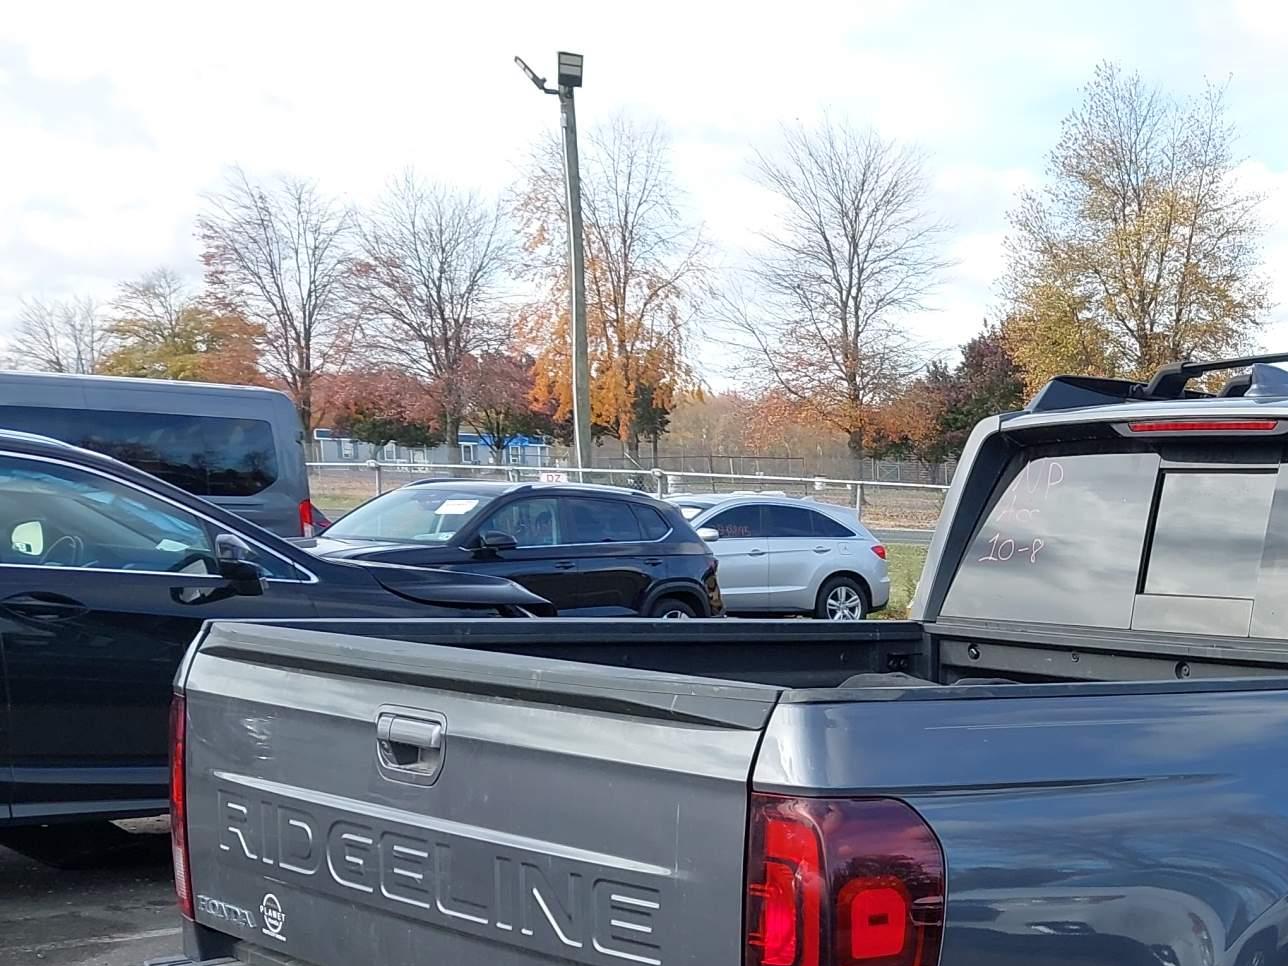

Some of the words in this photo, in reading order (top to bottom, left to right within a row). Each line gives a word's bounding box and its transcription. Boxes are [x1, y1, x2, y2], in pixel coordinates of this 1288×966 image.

[546, 474, 561, 482] DZ
[978, 533, 1044, 563] 10-8
[217, 789, 662, 966] RIDGELINE
[259, 904, 287, 922] PLANET
